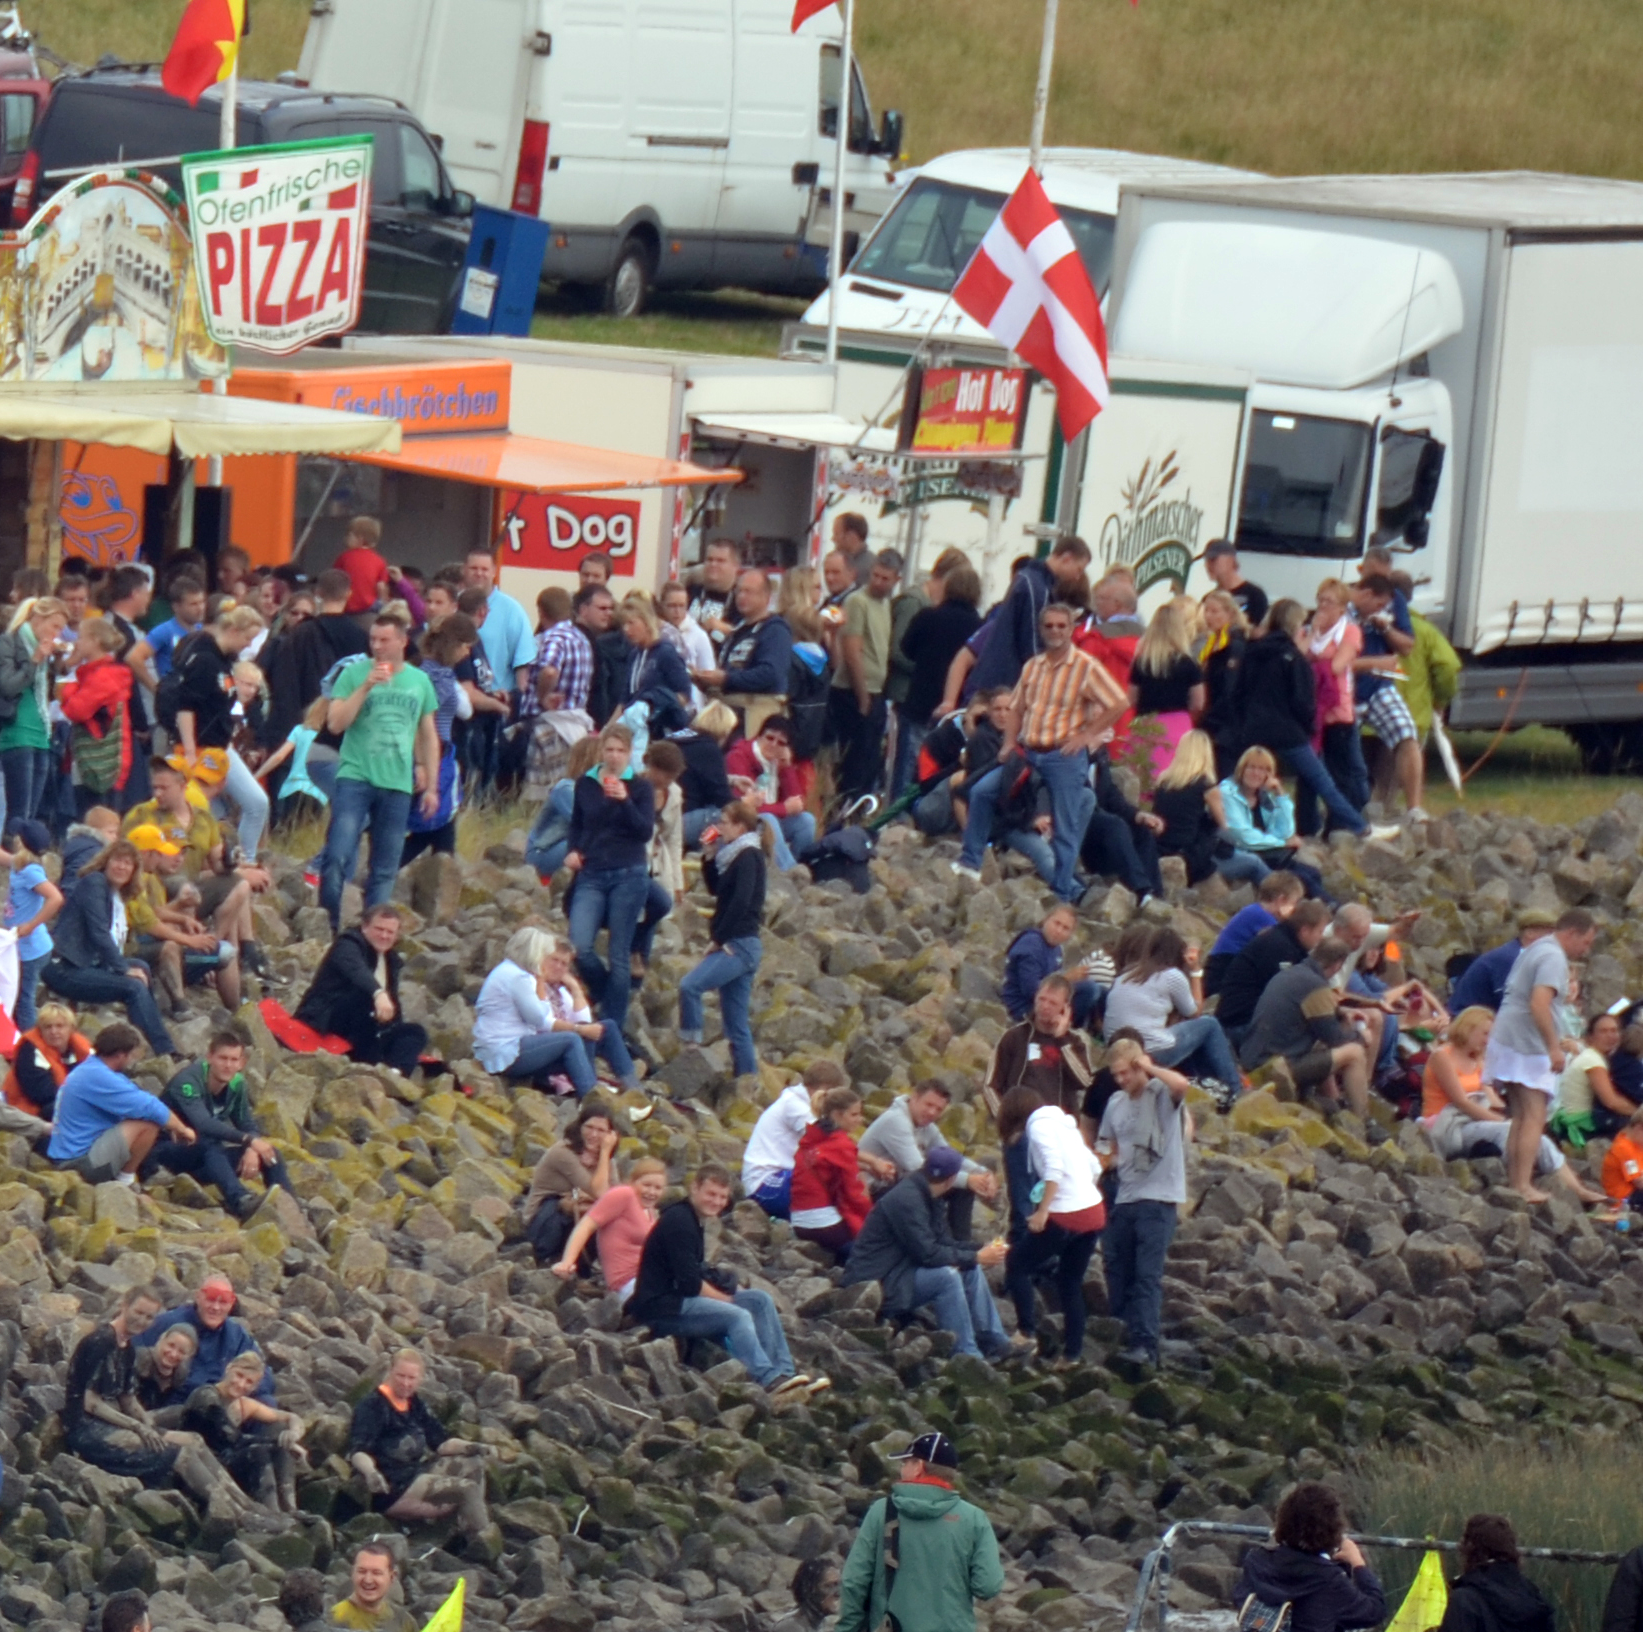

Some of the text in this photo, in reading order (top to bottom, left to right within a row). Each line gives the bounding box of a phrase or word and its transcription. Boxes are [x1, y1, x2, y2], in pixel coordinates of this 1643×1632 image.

[196, 158, 362, 226] Ofenfrische
[206, 217, 351, 327] PIZZA
[954, 371, 987, 412] Hot
[989, 371, 1019, 415] Dog
[546, 503, 634, 557] Dog
[1100, 486, 1204, 567] Dithmarscher
